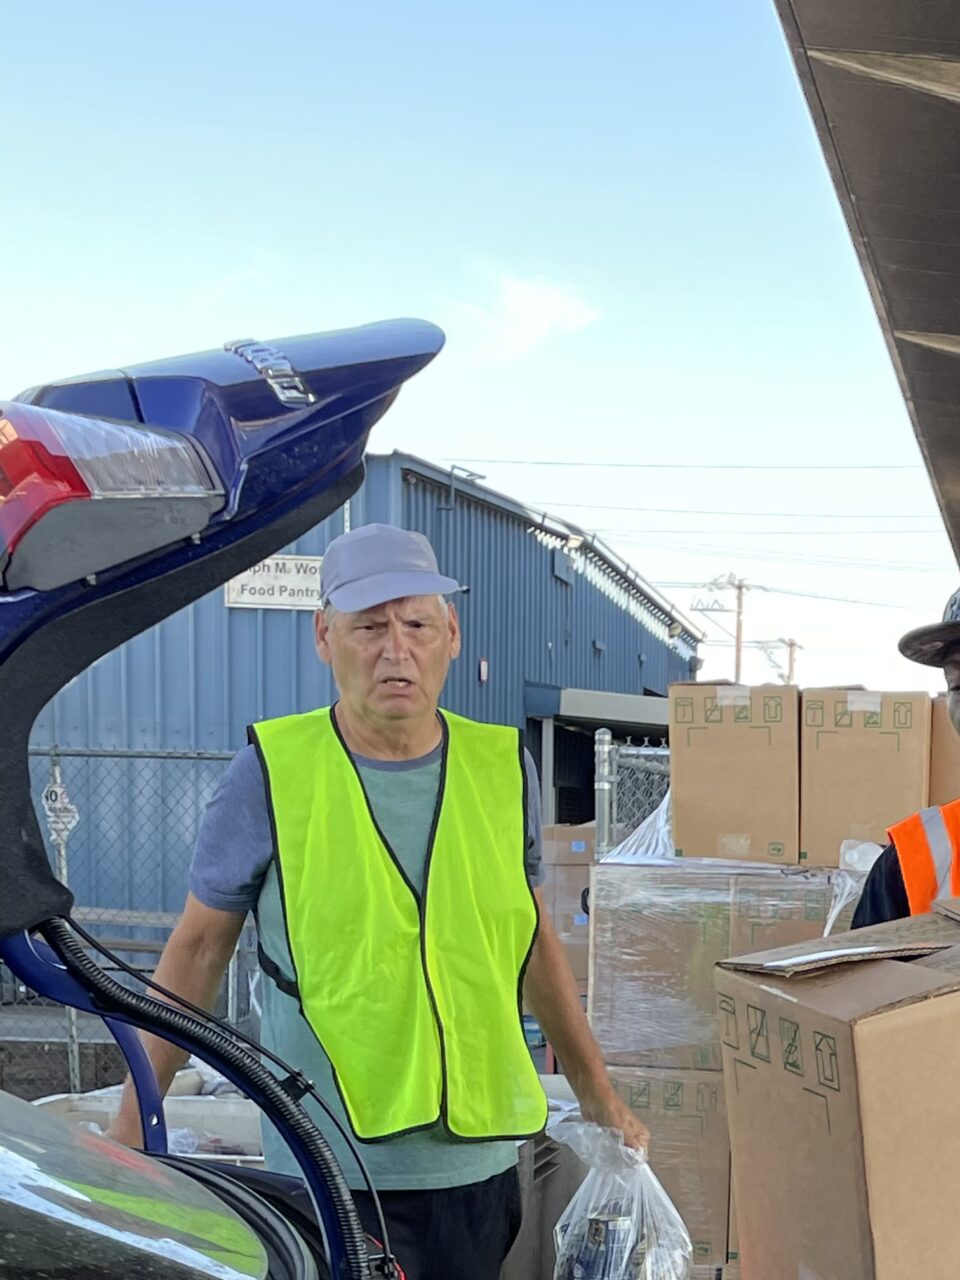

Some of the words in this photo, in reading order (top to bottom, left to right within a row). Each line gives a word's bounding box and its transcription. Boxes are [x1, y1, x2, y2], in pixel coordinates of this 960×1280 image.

[295, 562, 321, 575] Wo
[240, 584, 275, 596] Food
[279, 585, 321, 601] Pantry
